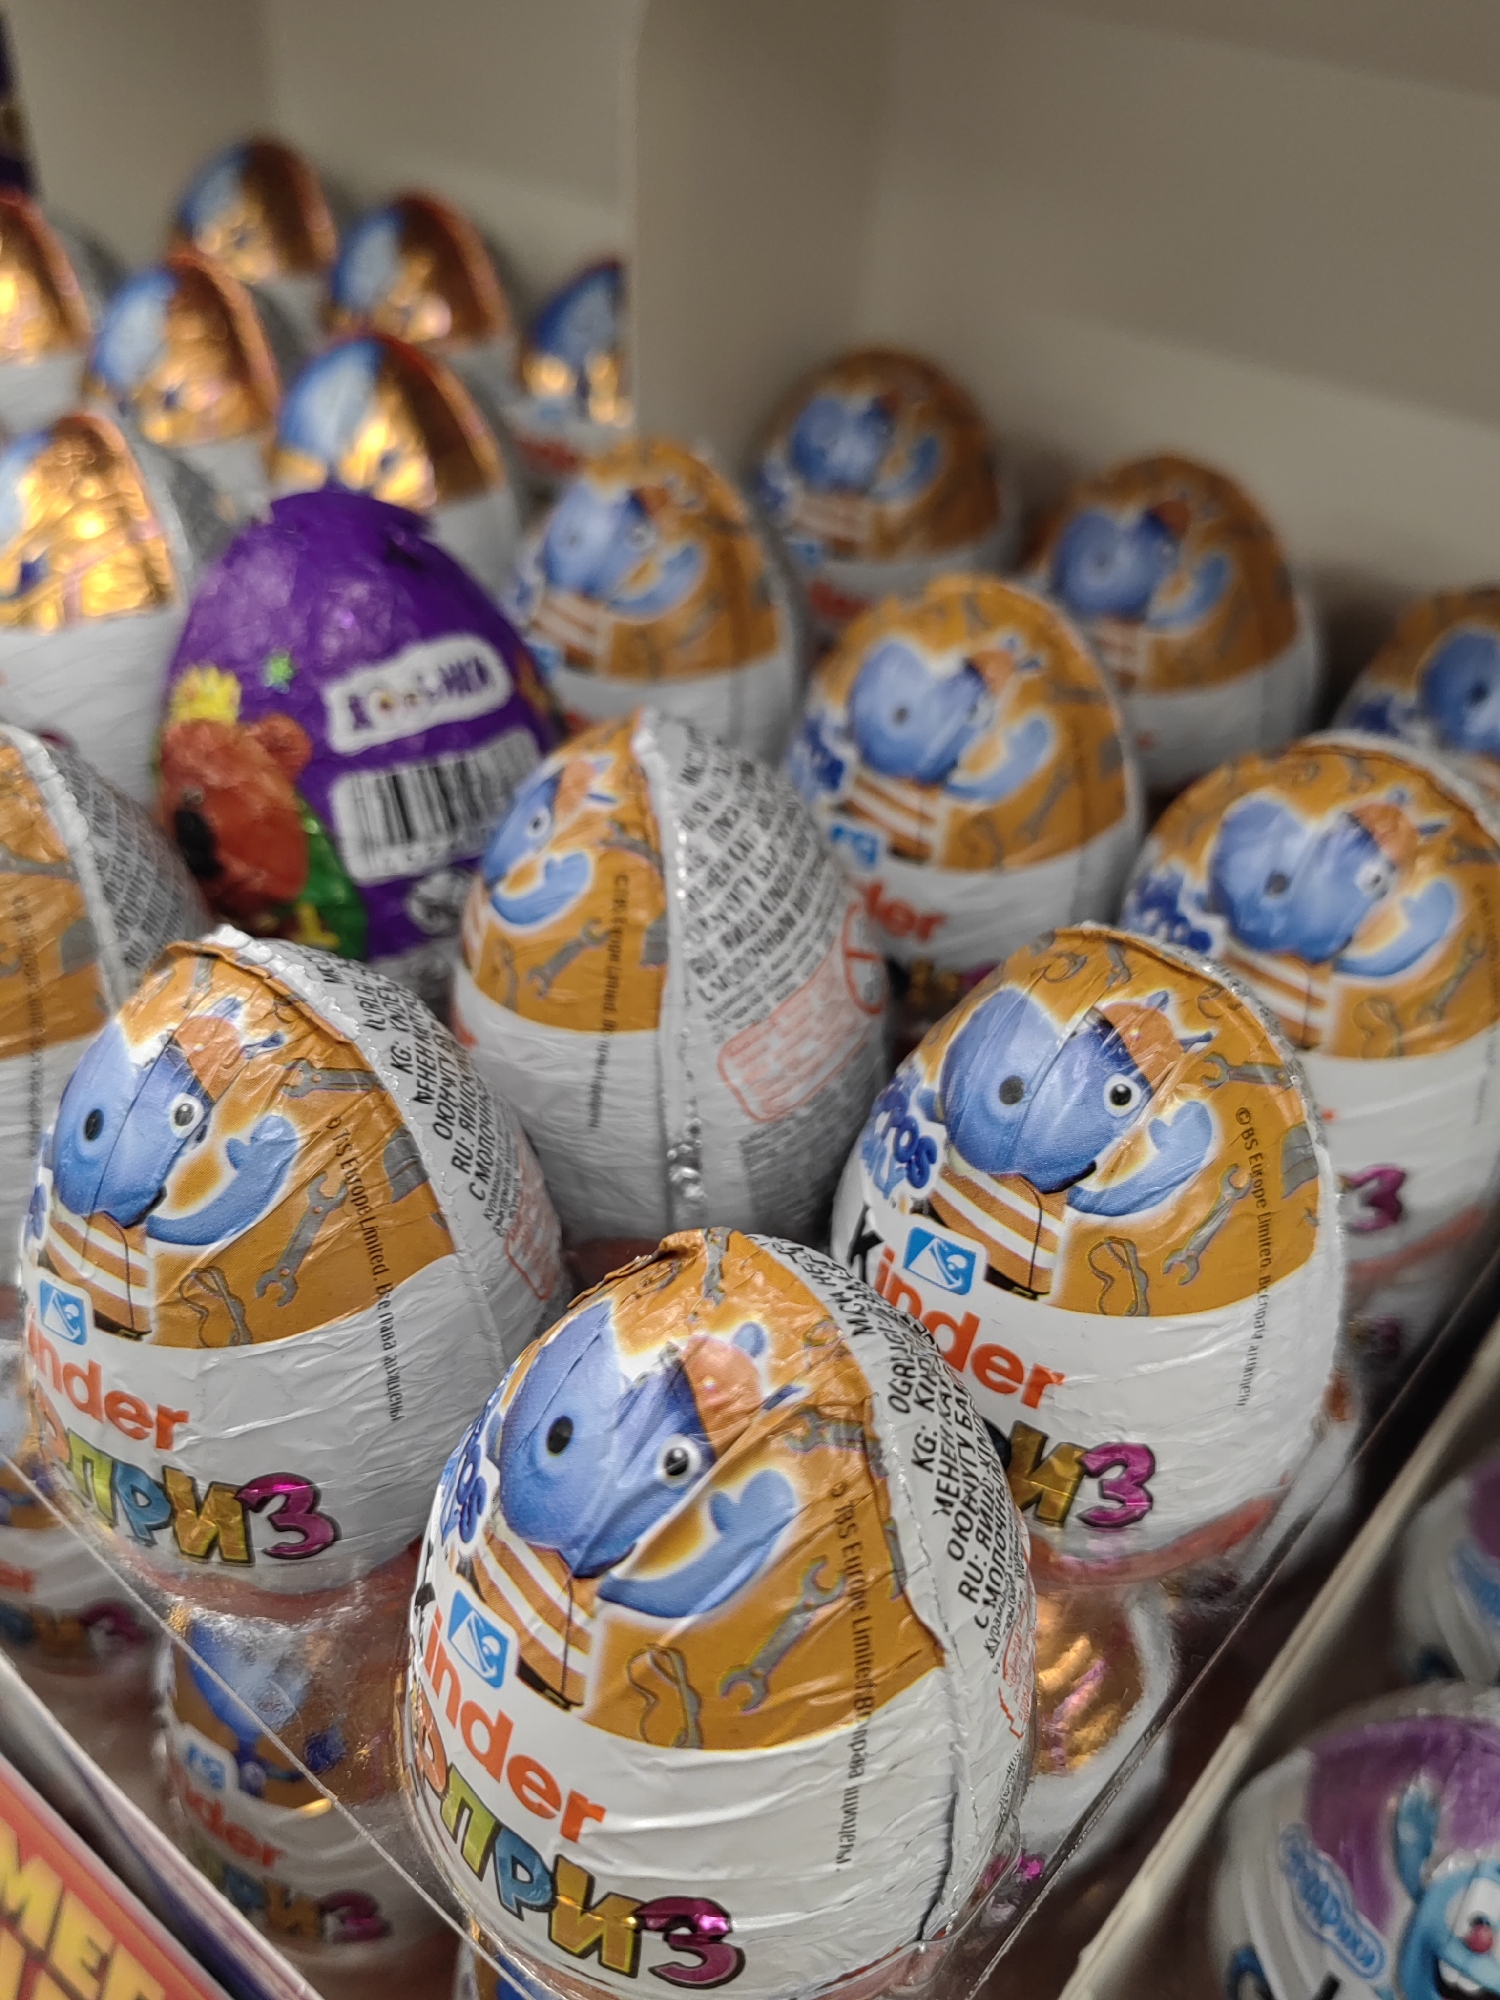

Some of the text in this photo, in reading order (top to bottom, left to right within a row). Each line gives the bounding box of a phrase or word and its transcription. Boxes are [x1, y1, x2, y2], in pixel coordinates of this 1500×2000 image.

[389, 1039, 413, 1074] KG:
[449, 1135, 473, 1174] RU:
[356, 1215, 390, 1282] Limited.
[908, 1424, 940, 1473] KG:
[956, 1553, 989, 1604] RU:
